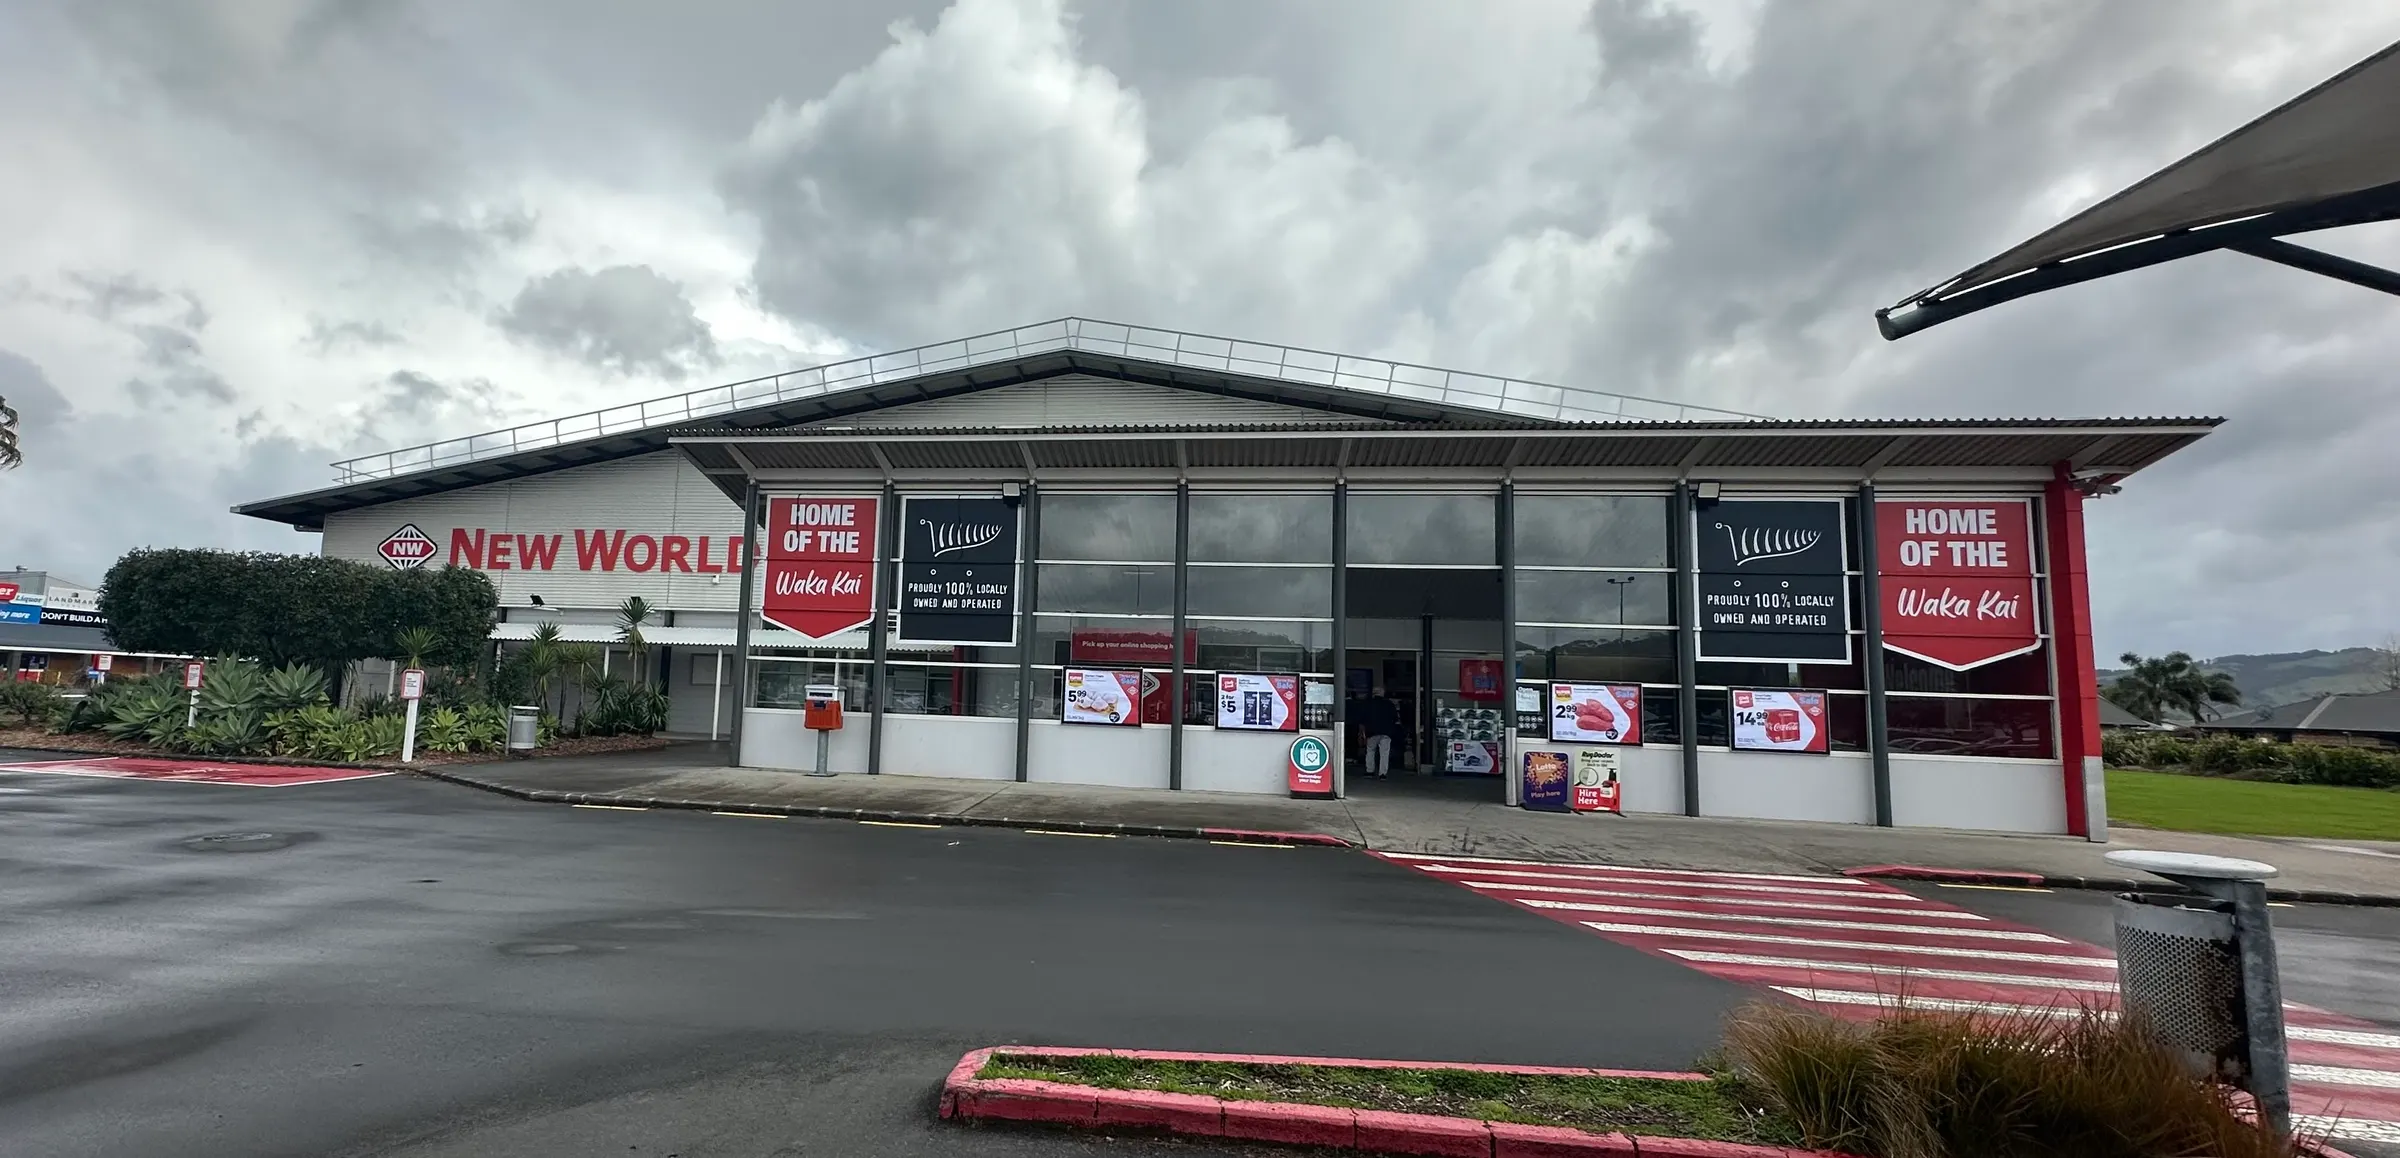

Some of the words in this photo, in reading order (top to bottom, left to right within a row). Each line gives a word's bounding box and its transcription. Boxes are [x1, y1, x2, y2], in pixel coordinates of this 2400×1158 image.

[790, 503, 855, 526] HOME
[1905, 508, 1997, 535] HOME
[392, 541, 425, 556] NW
[783, 530, 812, 552] OF
[817, 531, 860, 553] THE
[1900, 540, 1939, 566] OF
[1946, 541, 2008, 567] THE
[775, 569, 827, 596] Waka
[831, 570, 863, 597] Kai
[908, 582, 943, 594] PROUDLY
[945, 582, 974, 596] 100%
[976, 583, 1008, 595] LOCALLY
[913, 597, 938, 608] OWNED
[941, 598, 958, 609] AND
[961, 598, 1002, 609] OPERATED
[1707, 594, 1750, 606] PROUDLY
[1754, 593, 1791, 608] 100%
[1794, 595, 1834, 607] LOCALLY
[1897, 586, 1970, 619] Waka
[1976, 588, 2020, 620] Kai
[10, 611, 31, 619] more
[41, 611, 68, 621] DON'T
[69, 614, 93, 622] BUILD
[1713, 612, 1744, 624] OWNED
[1750, 613, 1770, 625] AND
[1775, 614, 1827, 626] OPERATED
[1140, 641, 1169, 650] shopping
[1068, 690, 1077, 702] 5
[1555, 705, 1566, 718] 2
[1736, 711, 1756, 725] 14
[1756, 711, 1768, 719] 99
[1579, 789, 1598, 797] Hire
[1578, 796, 1598, 805] Here
